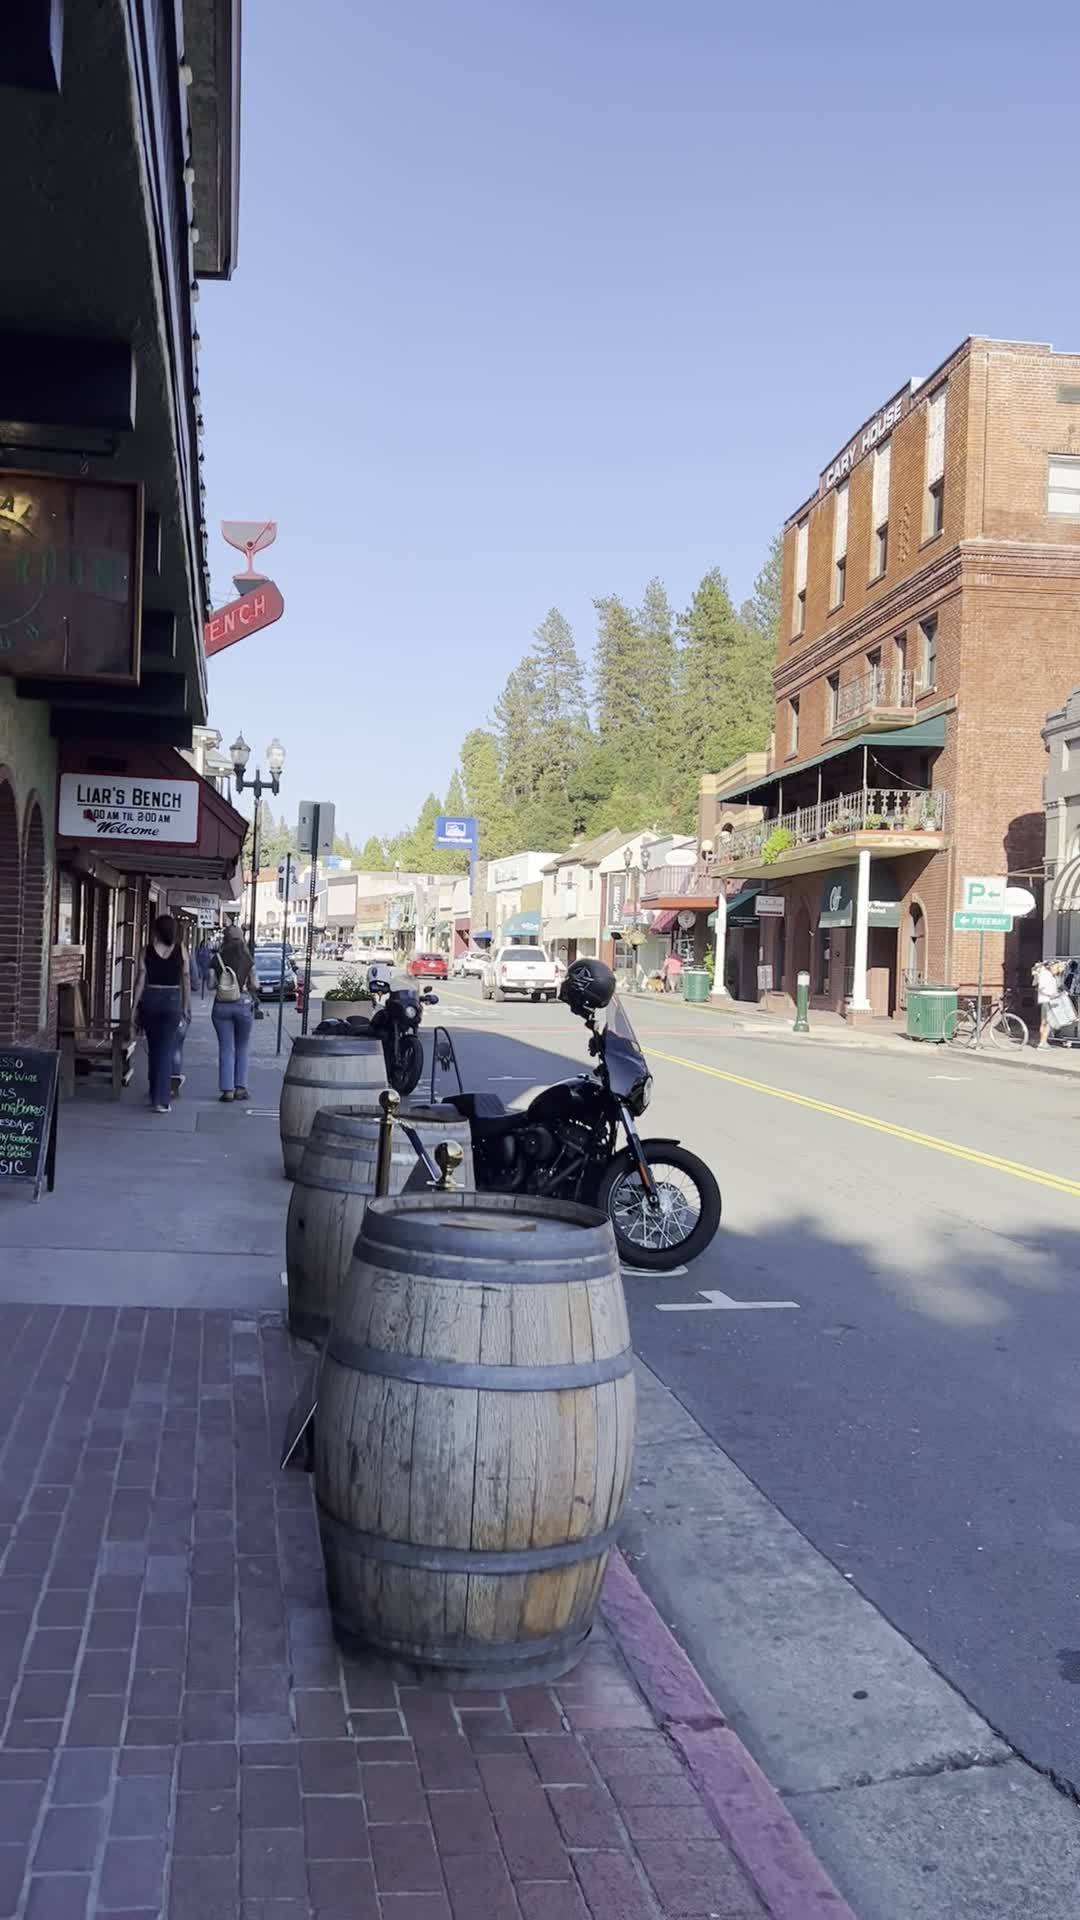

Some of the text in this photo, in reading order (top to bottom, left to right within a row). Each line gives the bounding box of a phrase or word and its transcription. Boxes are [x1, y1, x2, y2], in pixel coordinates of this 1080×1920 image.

[826, 397, 903, 489] CARY HOUSE
[206, 595, 265, 643] ENCH
[77, 784, 182, 808] LIAR'S BENCH
[107, 811, 119, 820] AM
[123, 812, 134, 822] TIL
[158, 814, 171, 823] AM
[97, 821, 159, 836] Welcome
[0, 1160, 27, 1175] SIC
